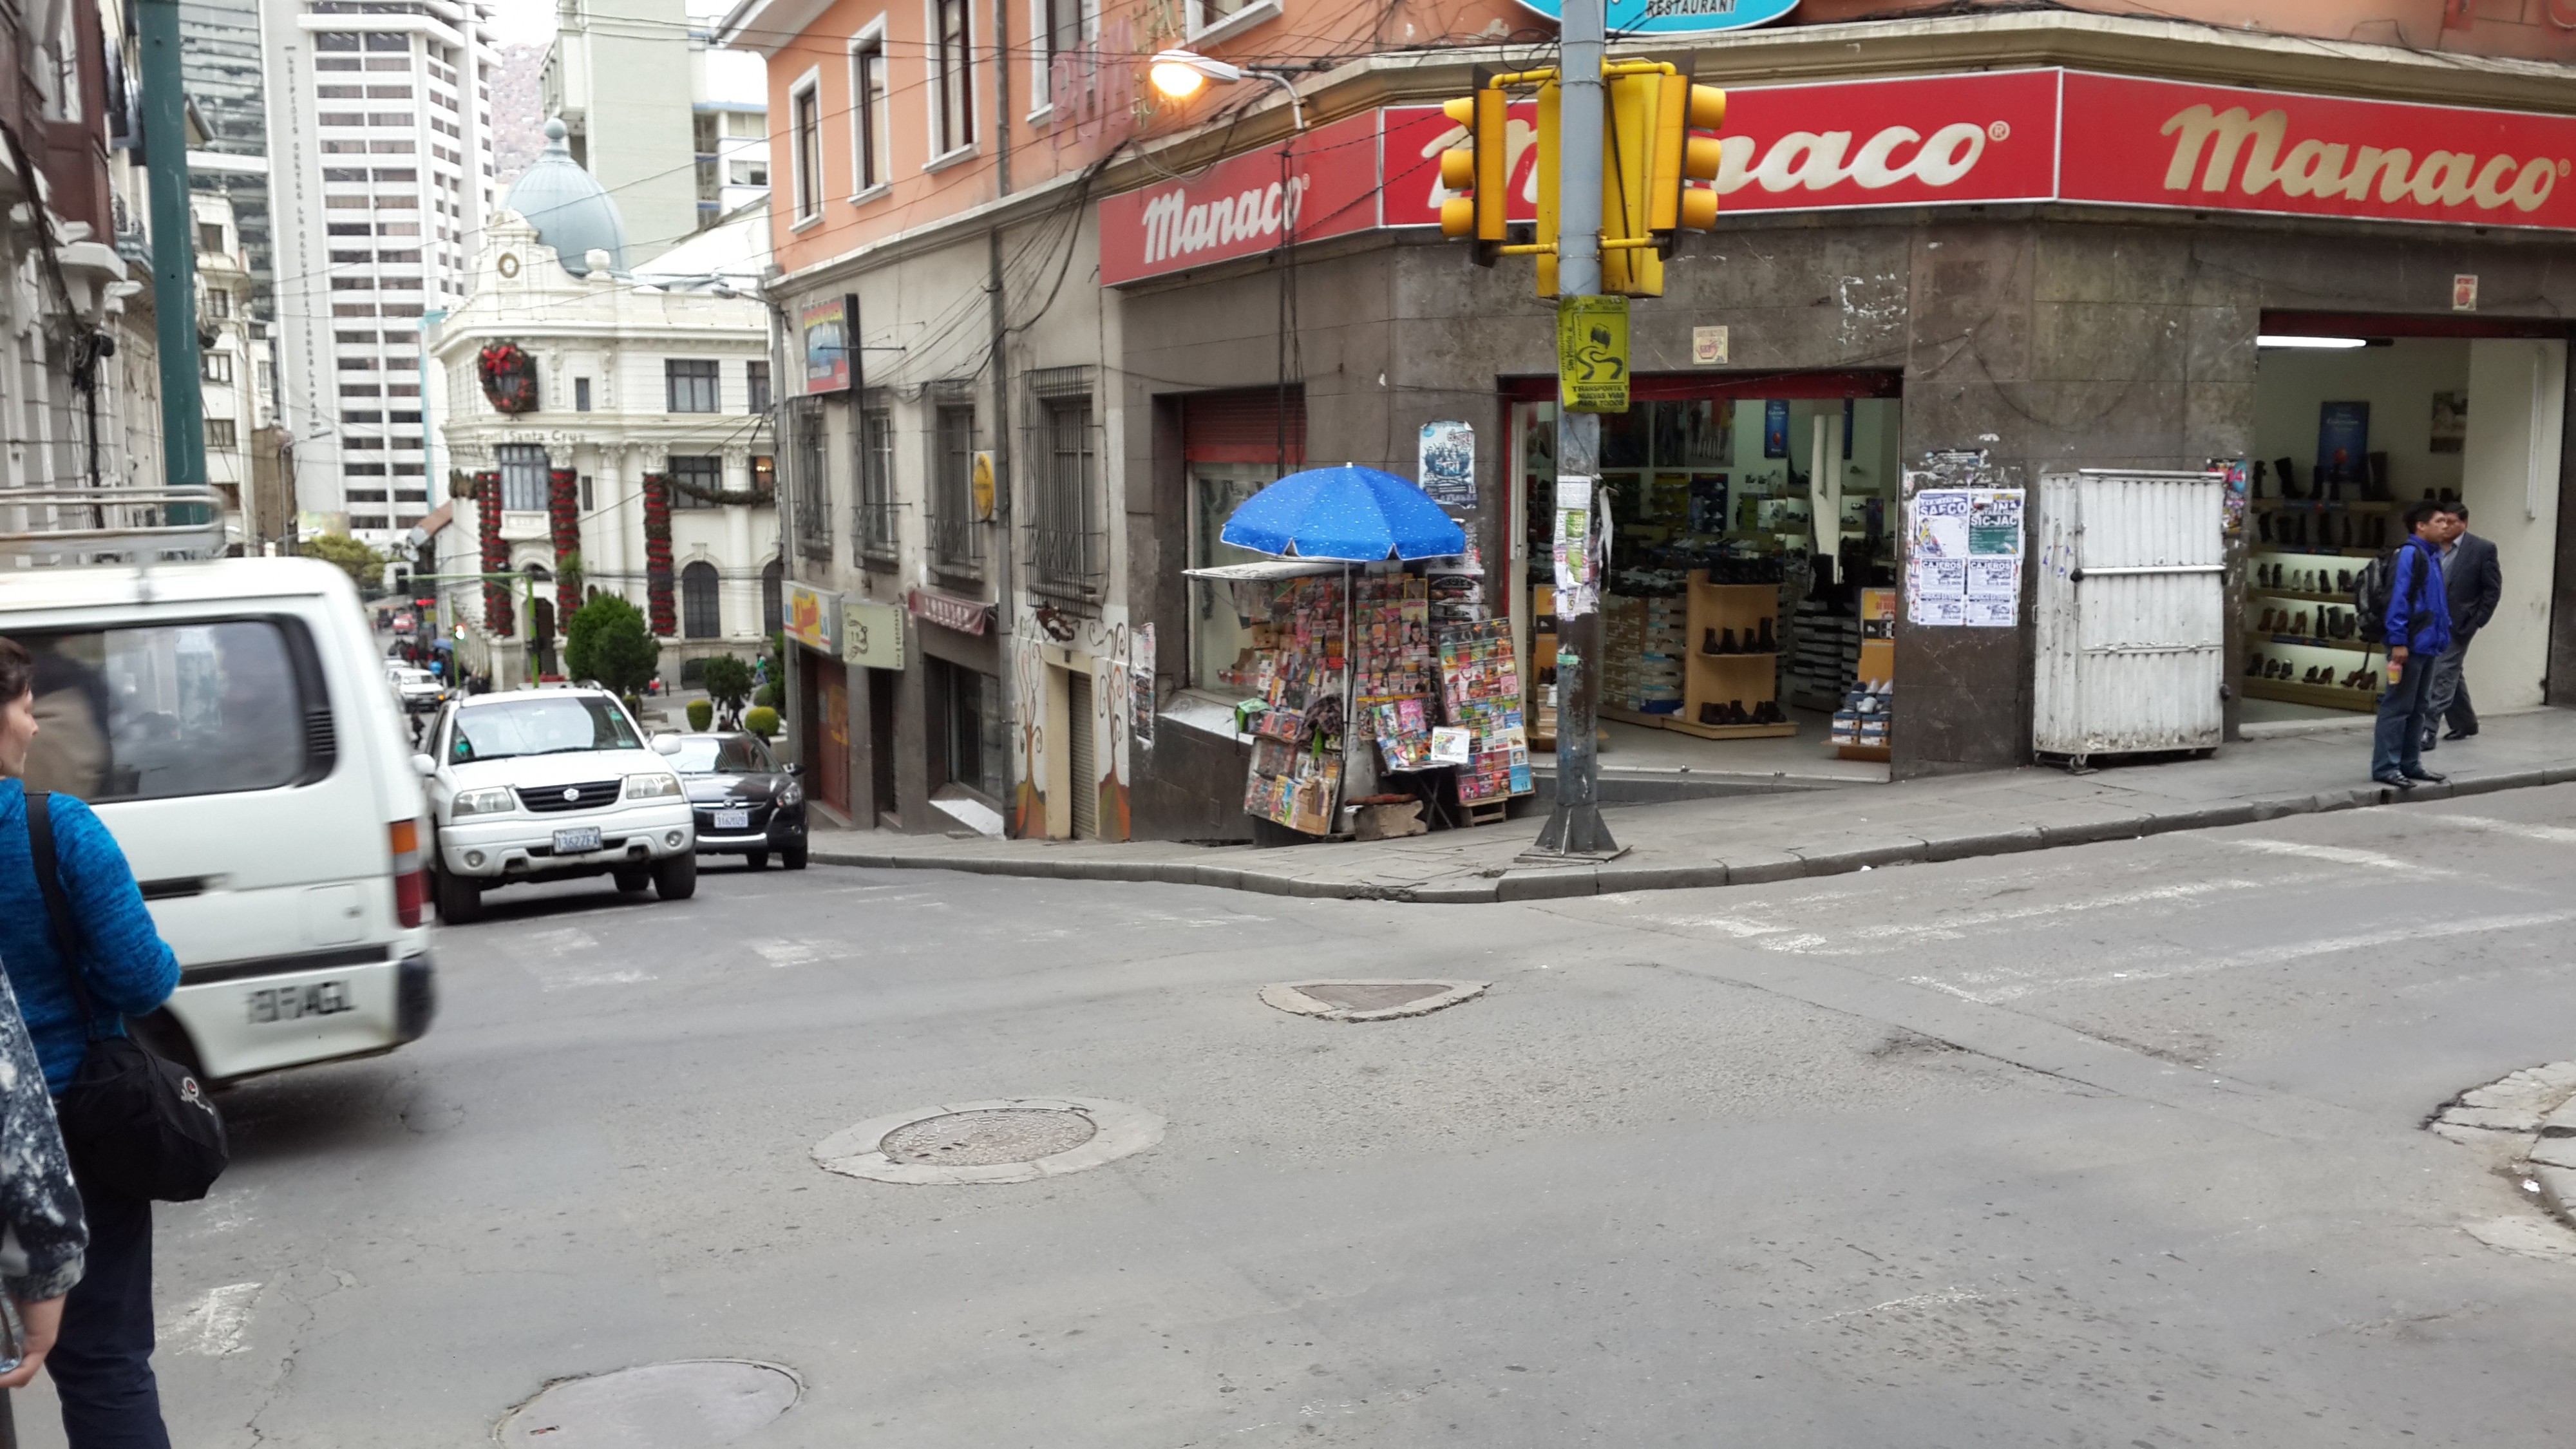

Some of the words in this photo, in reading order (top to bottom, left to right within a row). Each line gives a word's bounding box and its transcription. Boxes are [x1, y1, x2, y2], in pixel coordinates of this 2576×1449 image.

[1646, 0, 1736, 16] RESTAURANT
[2160, 103, 2557, 212] Manaco
[1142, 176, 1303, 264] Manaco
[1920, 502, 1967, 516] SAFCO
[1922, 561, 1962, 570] CAJEROS
[1970, 562, 2011, 570] CAJEROS
